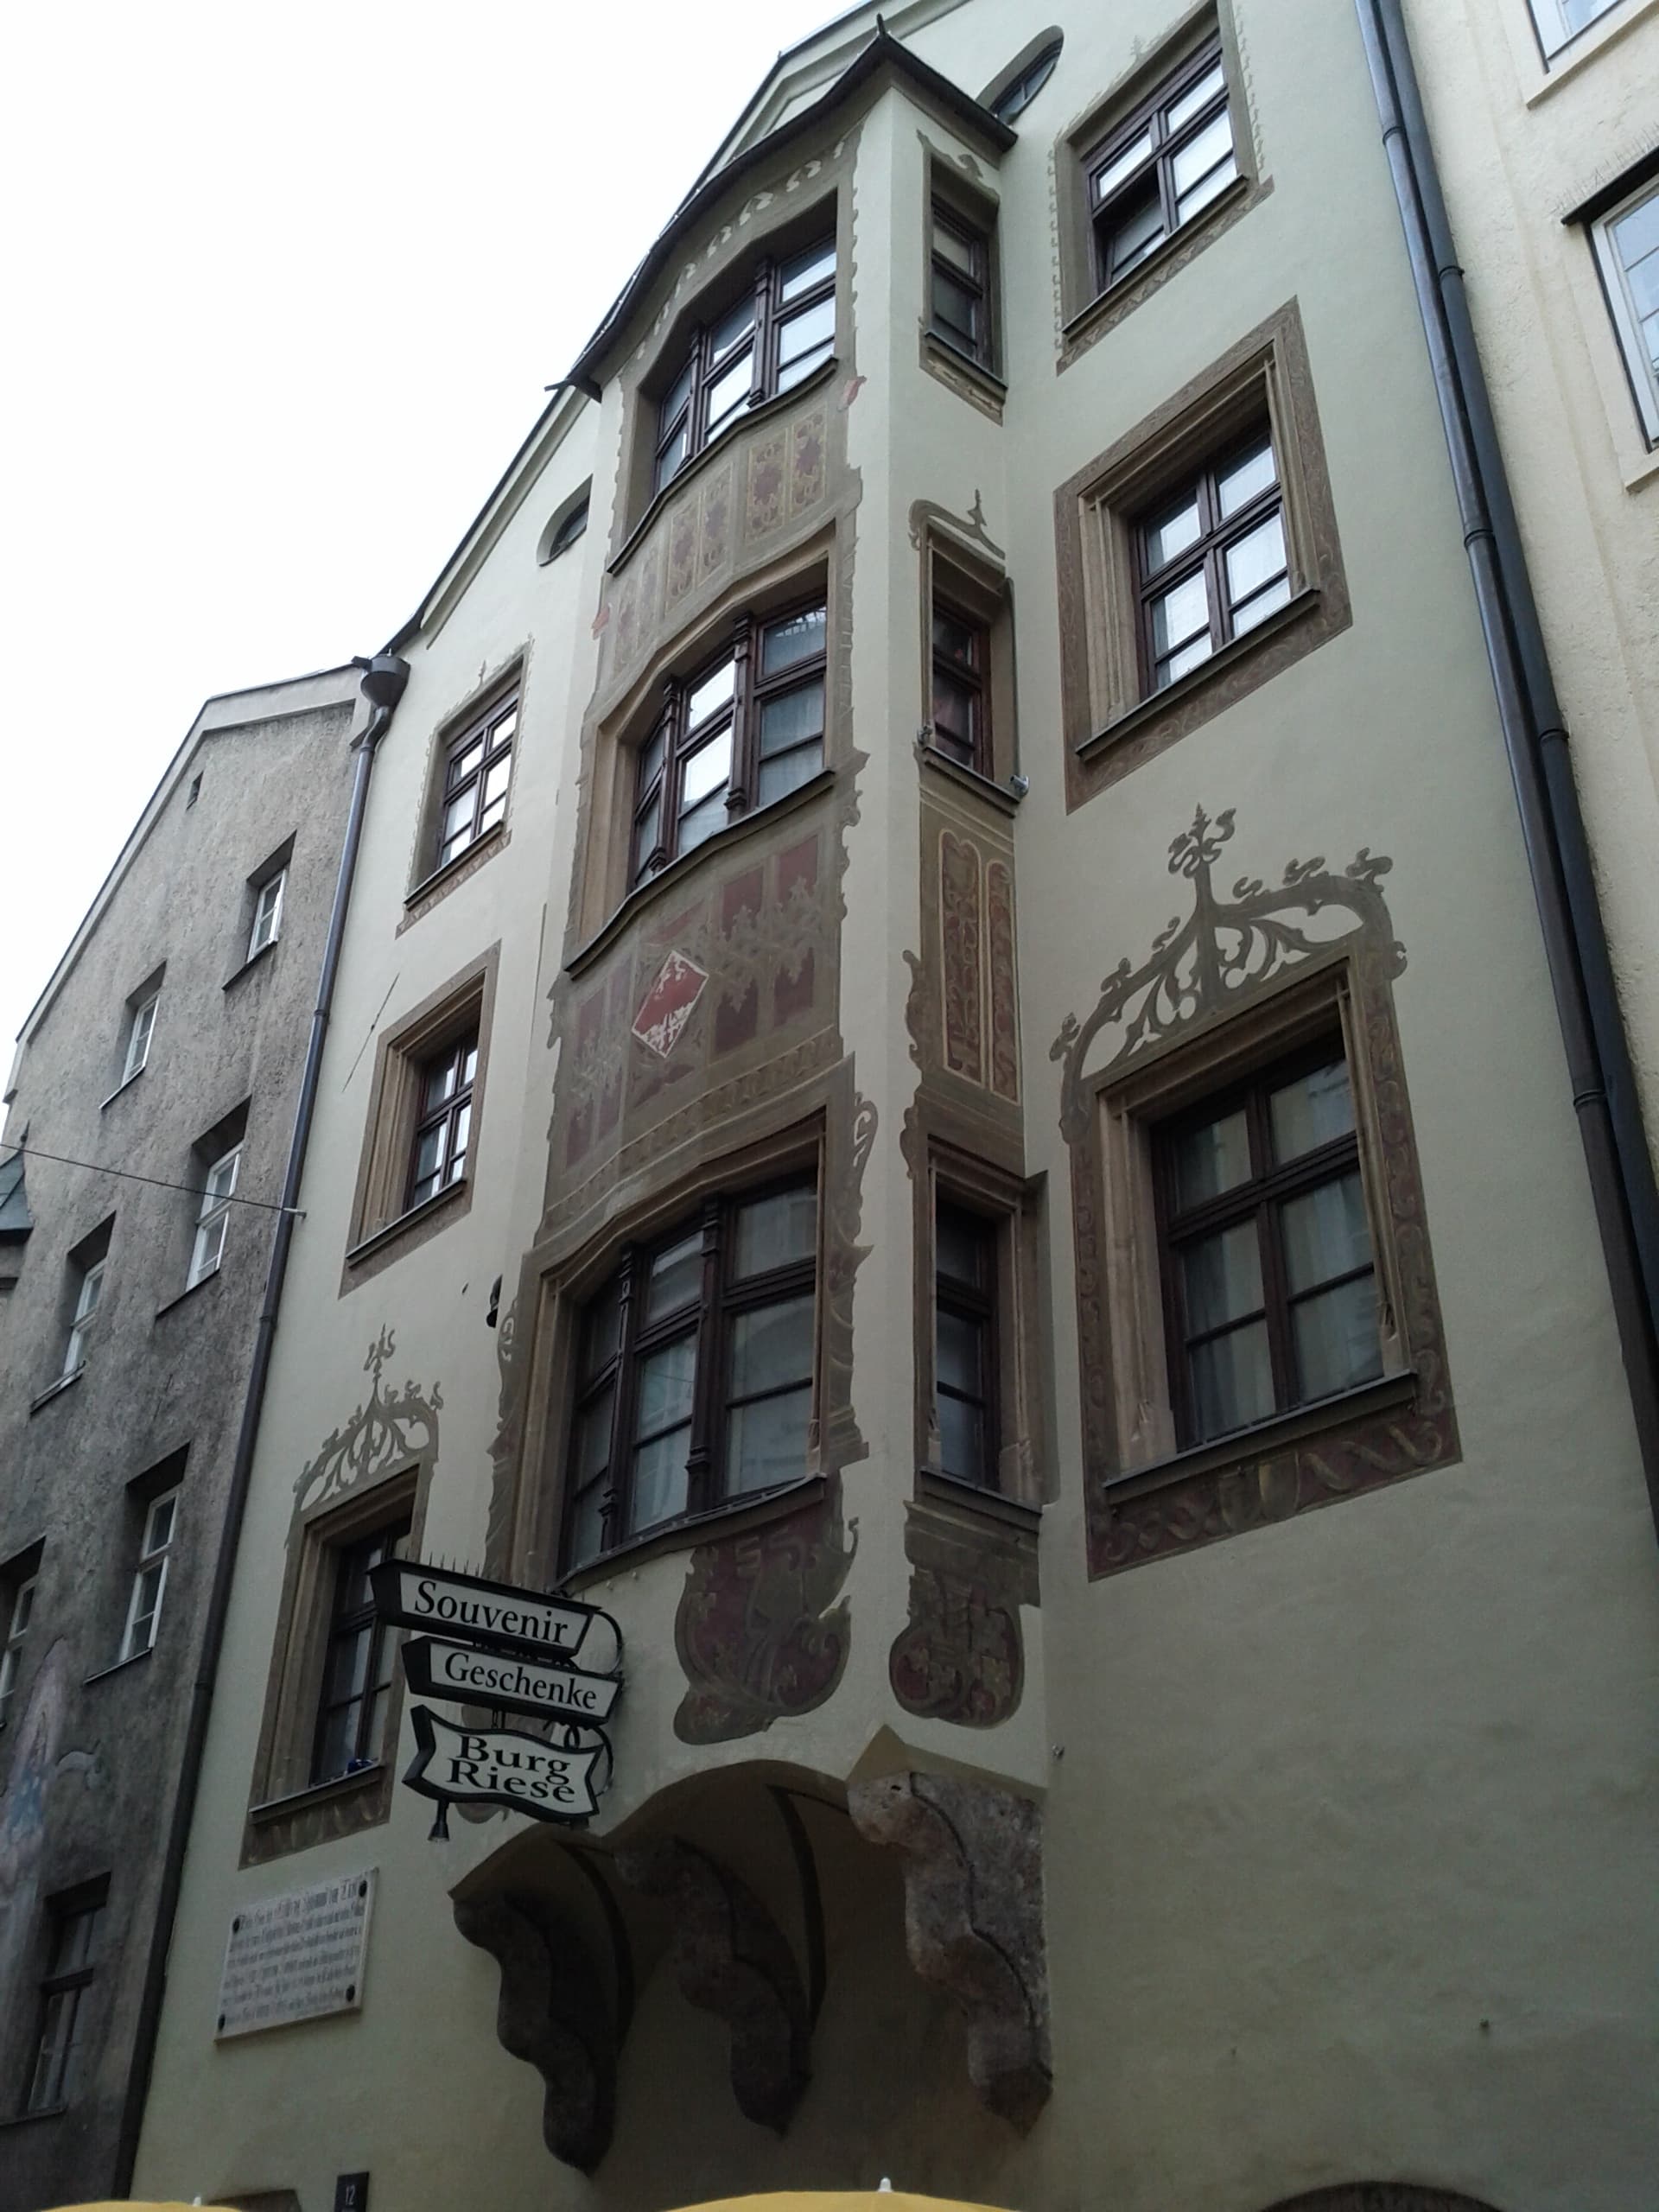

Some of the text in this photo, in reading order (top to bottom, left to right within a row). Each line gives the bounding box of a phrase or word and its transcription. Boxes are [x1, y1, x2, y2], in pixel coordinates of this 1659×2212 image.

[415, 1580, 568, 1643] Souvenir
[445, 1652, 596, 1710] Geschenke
[446, 1758, 575, 1803] Riese
[458, 1735, 571, 1784] Burg
[346, 2184, 356, 2205] 12
